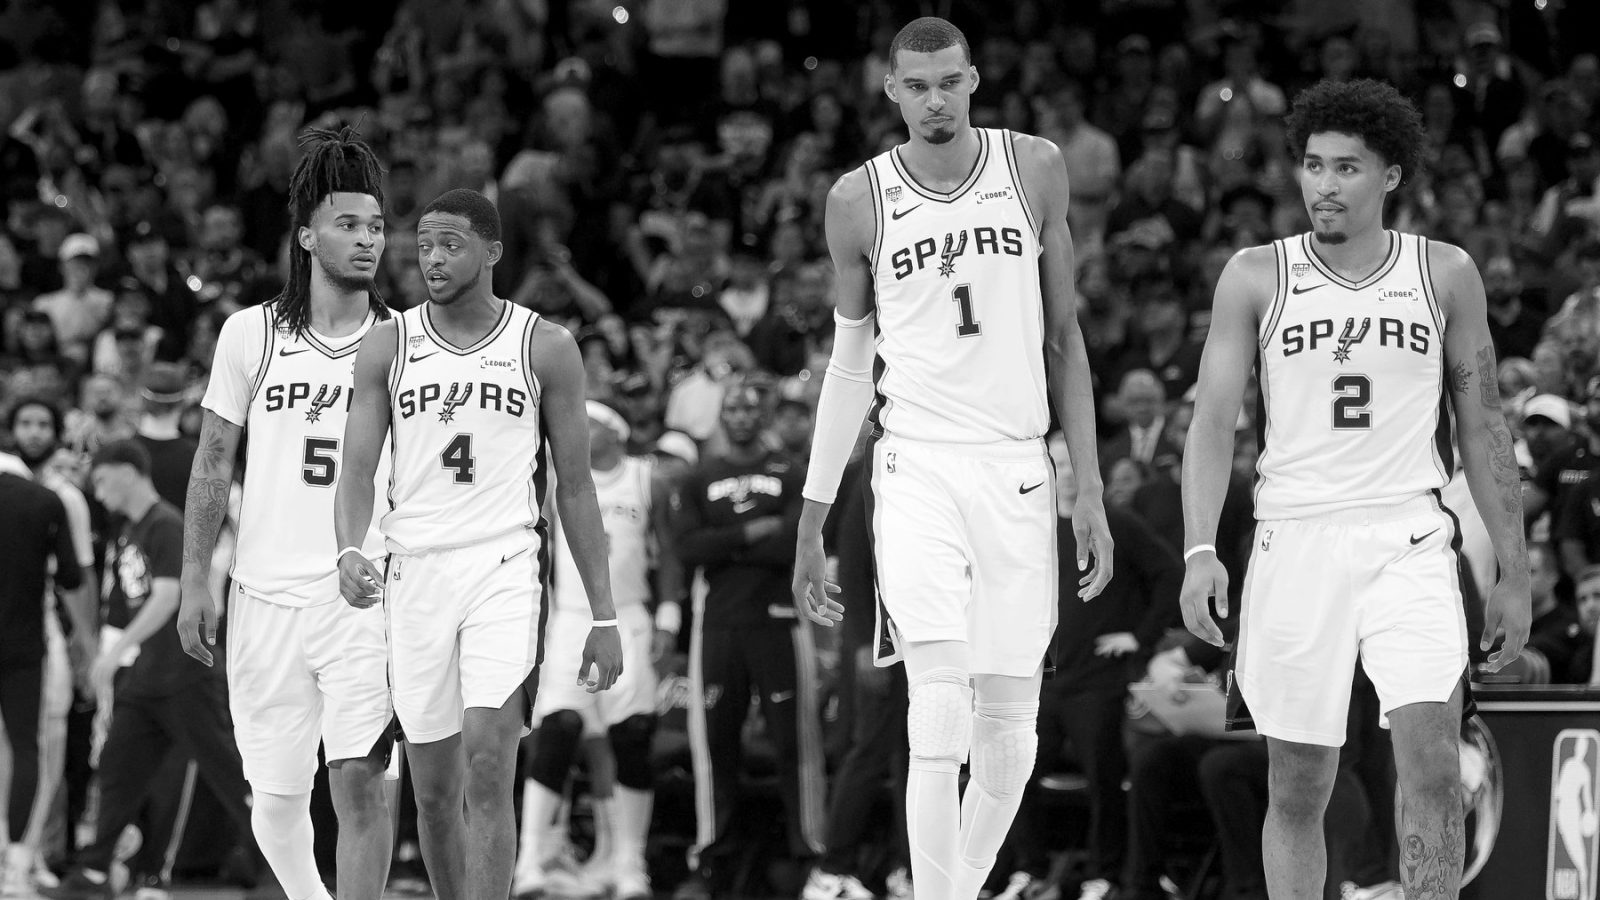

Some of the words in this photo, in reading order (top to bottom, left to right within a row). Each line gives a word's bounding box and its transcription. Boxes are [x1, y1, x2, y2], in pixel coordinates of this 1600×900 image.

[980, 190, 1007, 201] LEDGER
[891, 226, 1023, 281] SPURS
[951, 282, 982, 339] 1
[1383, 290, 1413, 298] LEDGER
[484, 360, 512, 368] LEDGER
[1282, 317, 1430, 365] SPURS
[266, 382, 354, 424] SPU
[398, 382, 526, 425] SPURS
[1331, 373, 1373, 431] 2
[301, 435, 340, 488] 5
[439, 432, 476, 485] 4
